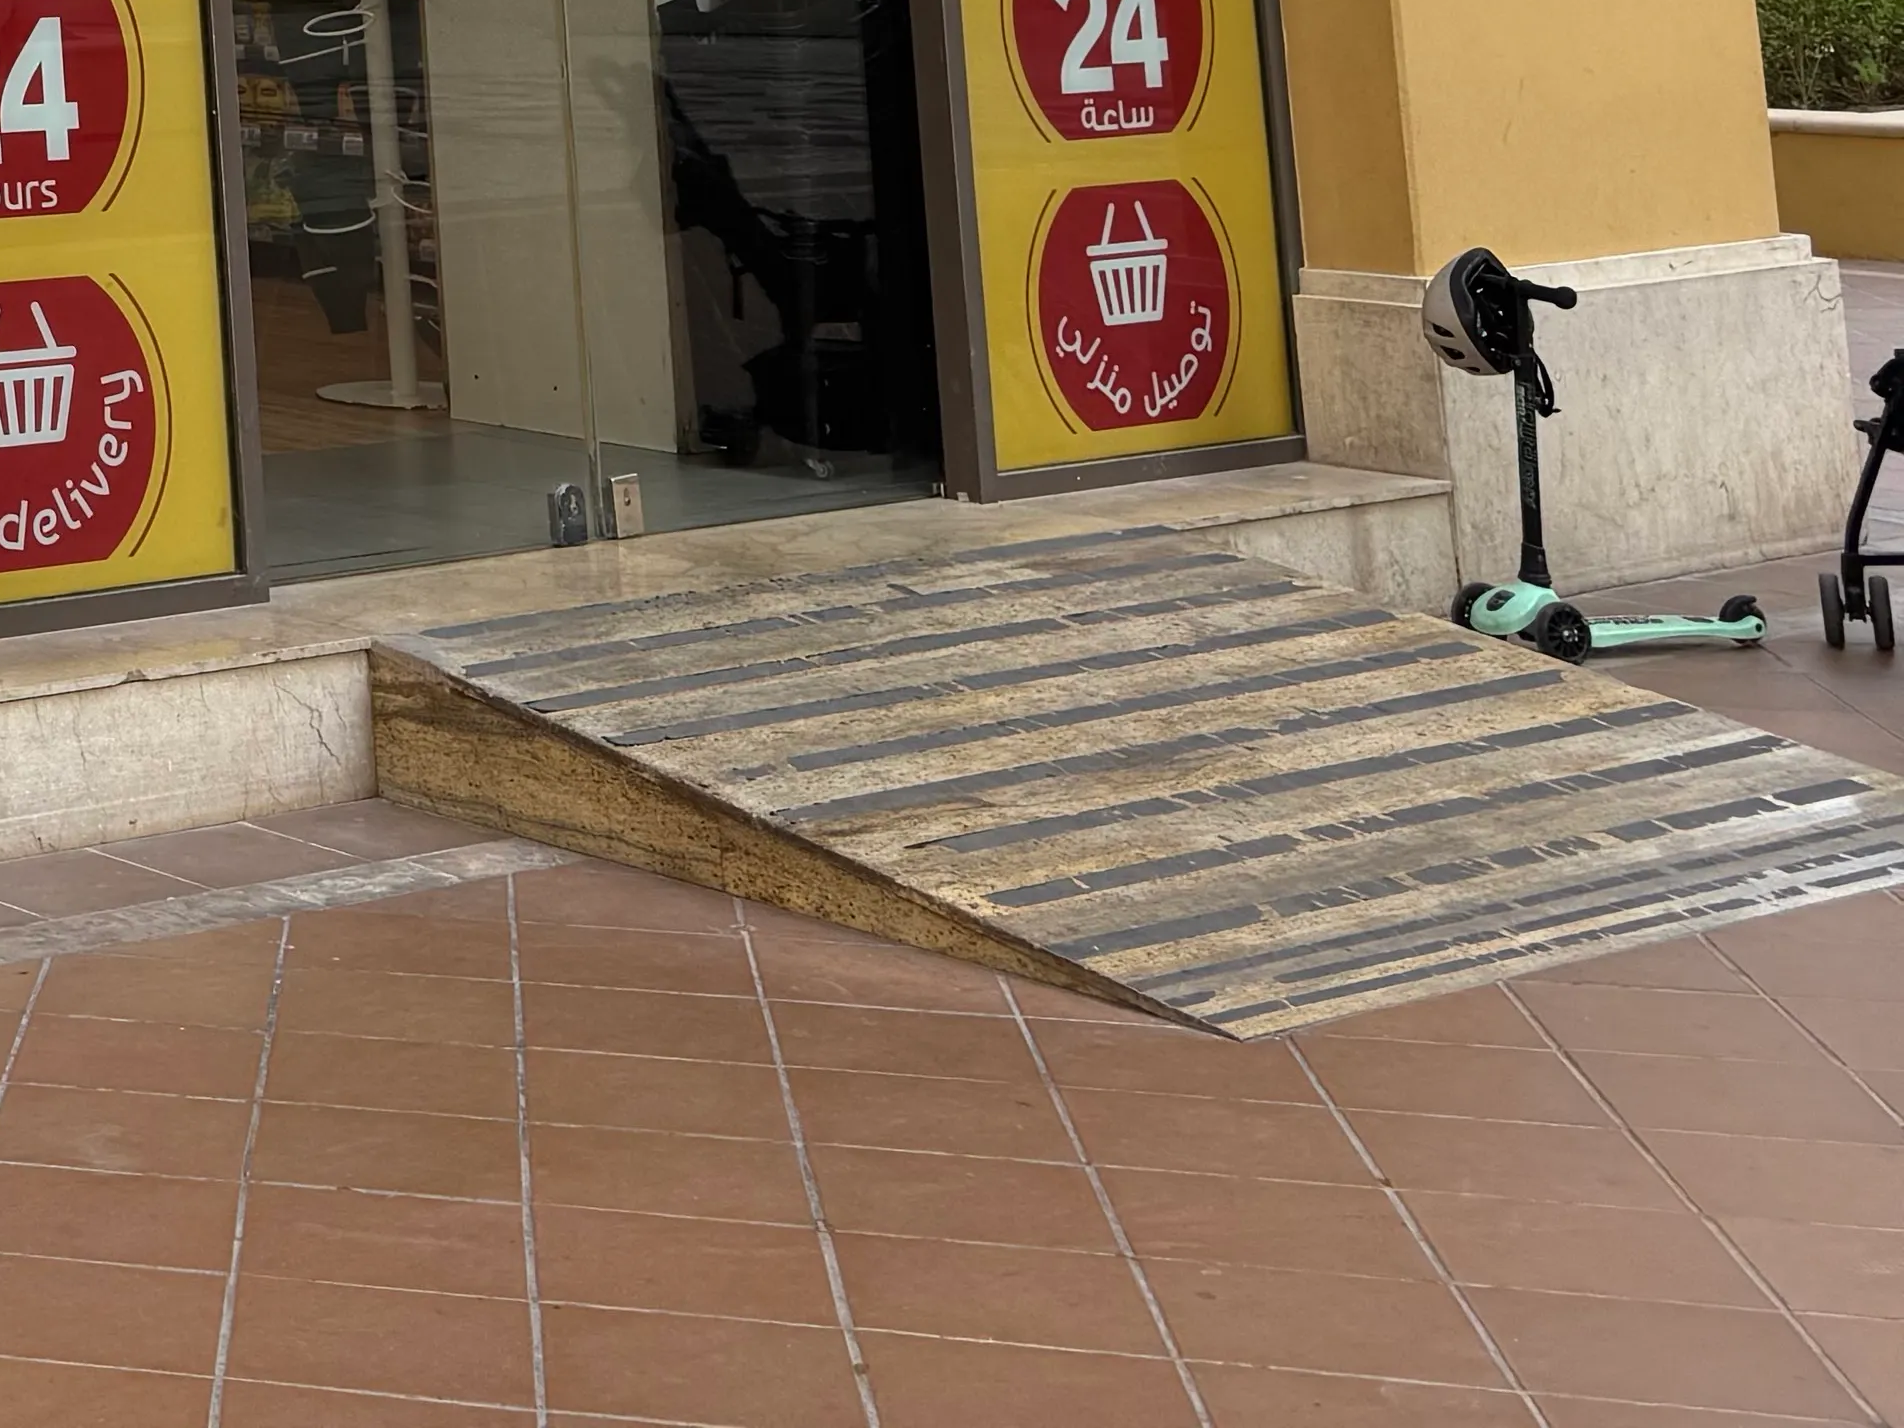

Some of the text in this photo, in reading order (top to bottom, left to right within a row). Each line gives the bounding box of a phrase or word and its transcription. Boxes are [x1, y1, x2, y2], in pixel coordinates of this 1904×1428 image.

[1080, 97, 1155, 132] ساعة
[1054, 299, 1216, 418] توصيل منزلي
